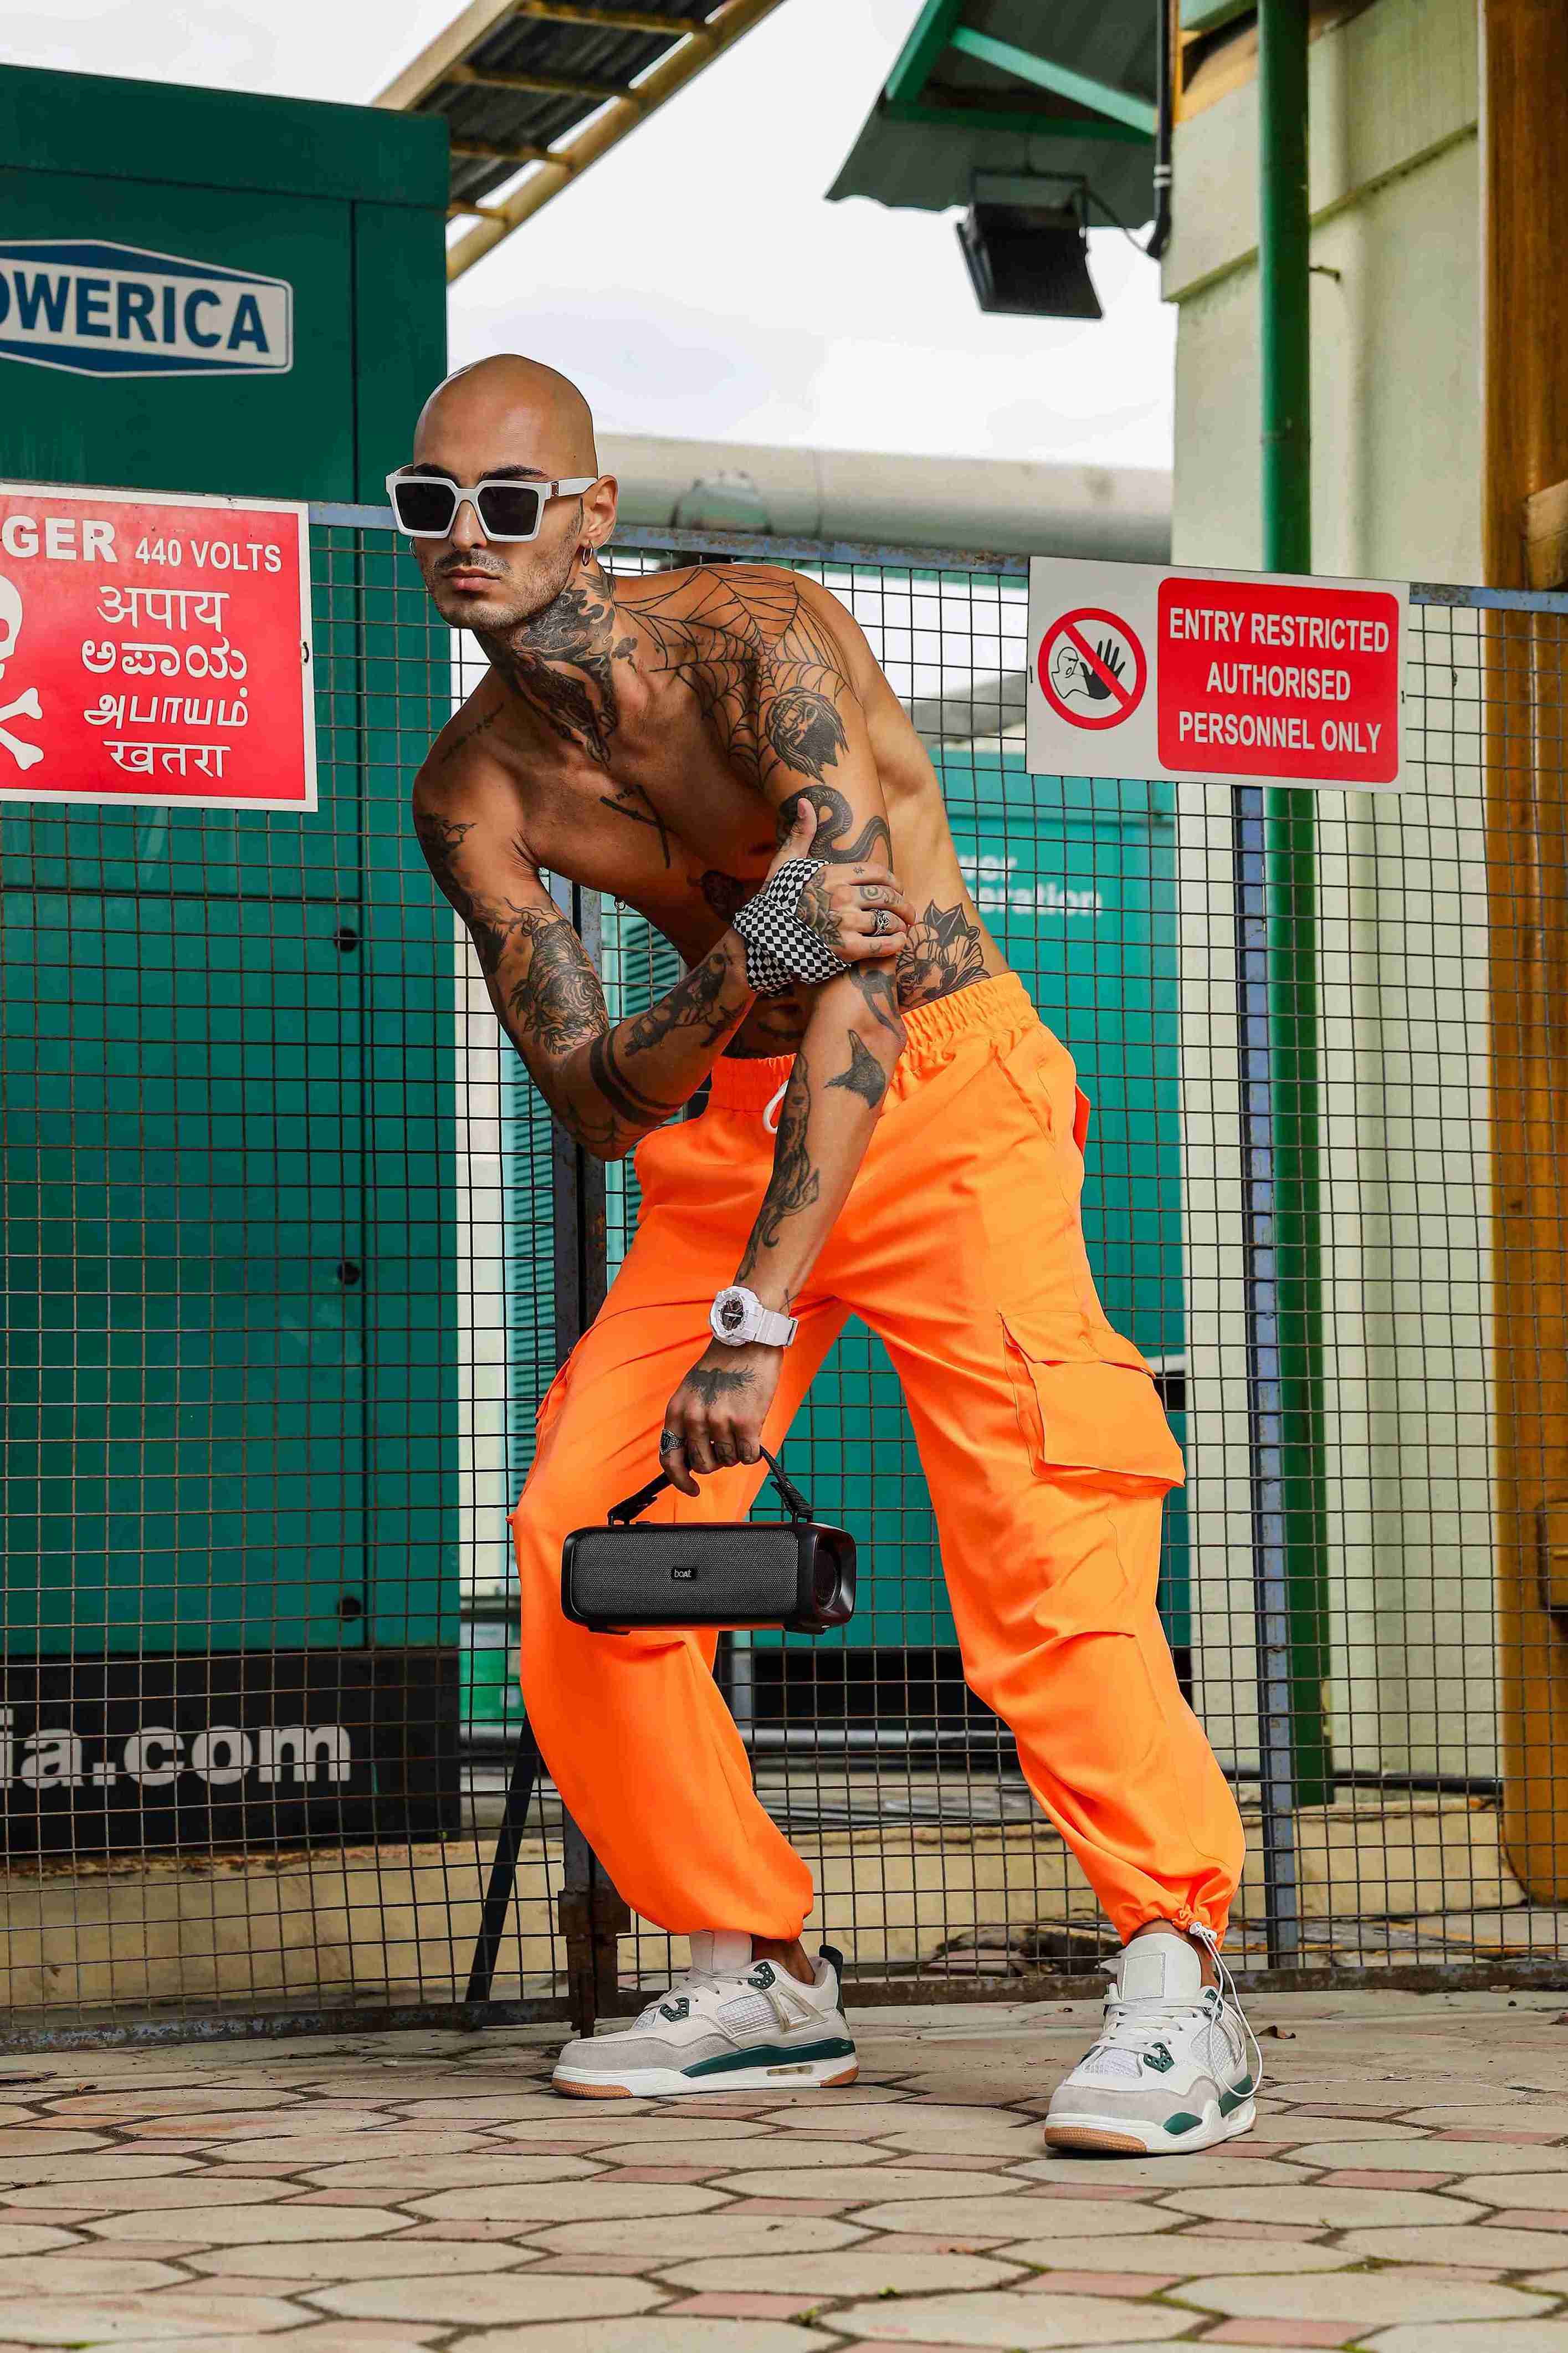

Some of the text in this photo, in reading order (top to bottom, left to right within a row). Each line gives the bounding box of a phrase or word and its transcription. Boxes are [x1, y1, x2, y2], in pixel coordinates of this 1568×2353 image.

[0, 270, 269, 353] WERICA
[1, 515, 282, 572] GER 440 VOLTS
[96, 585, 231, 633] अपाय
[1170, 607, 1390, 653] ENTRY RESTRICTED
[81, 636, 248, 681] ಅಪಾಯ
[1206, 662, 1351, 700] AUTHORISED
[83, 687, 249, 729] அபாயம்
[1178, 711, 1382, 754] PERSONNEL ONLY
[103, 740, 231, 778] खतरा
